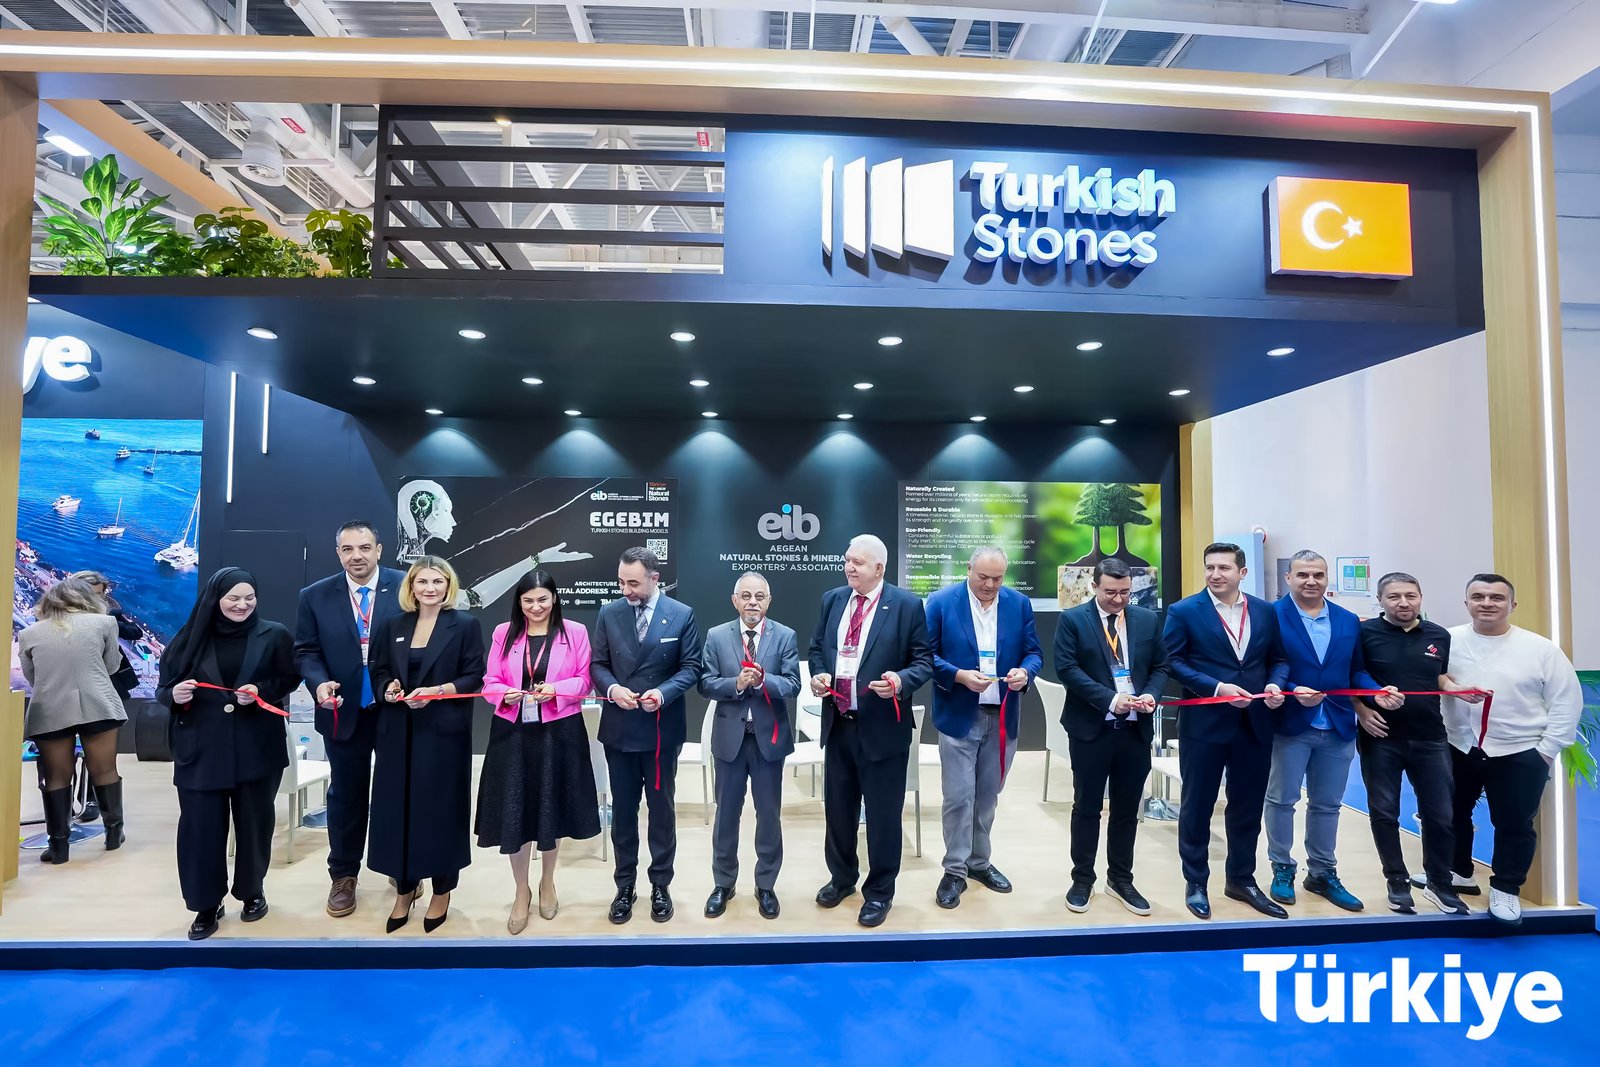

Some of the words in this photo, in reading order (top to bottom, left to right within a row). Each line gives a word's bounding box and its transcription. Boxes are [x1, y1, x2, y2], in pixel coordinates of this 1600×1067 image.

[969, 161, 1177, 218] Turkish
[973, 213, 1158, 268] Stones
[590, 490, 608, 500] eib
[590, 512, 670, 528] EGEBIM
[758, 504, 820, 540] eib
[770, 544, 808, 552] AEGEAN
[811, 554, 846, 562] MINERA
[732, 563, 788, 571] EXPORTERS'
[790, 564, 844, 572] ASSOCIATIO
